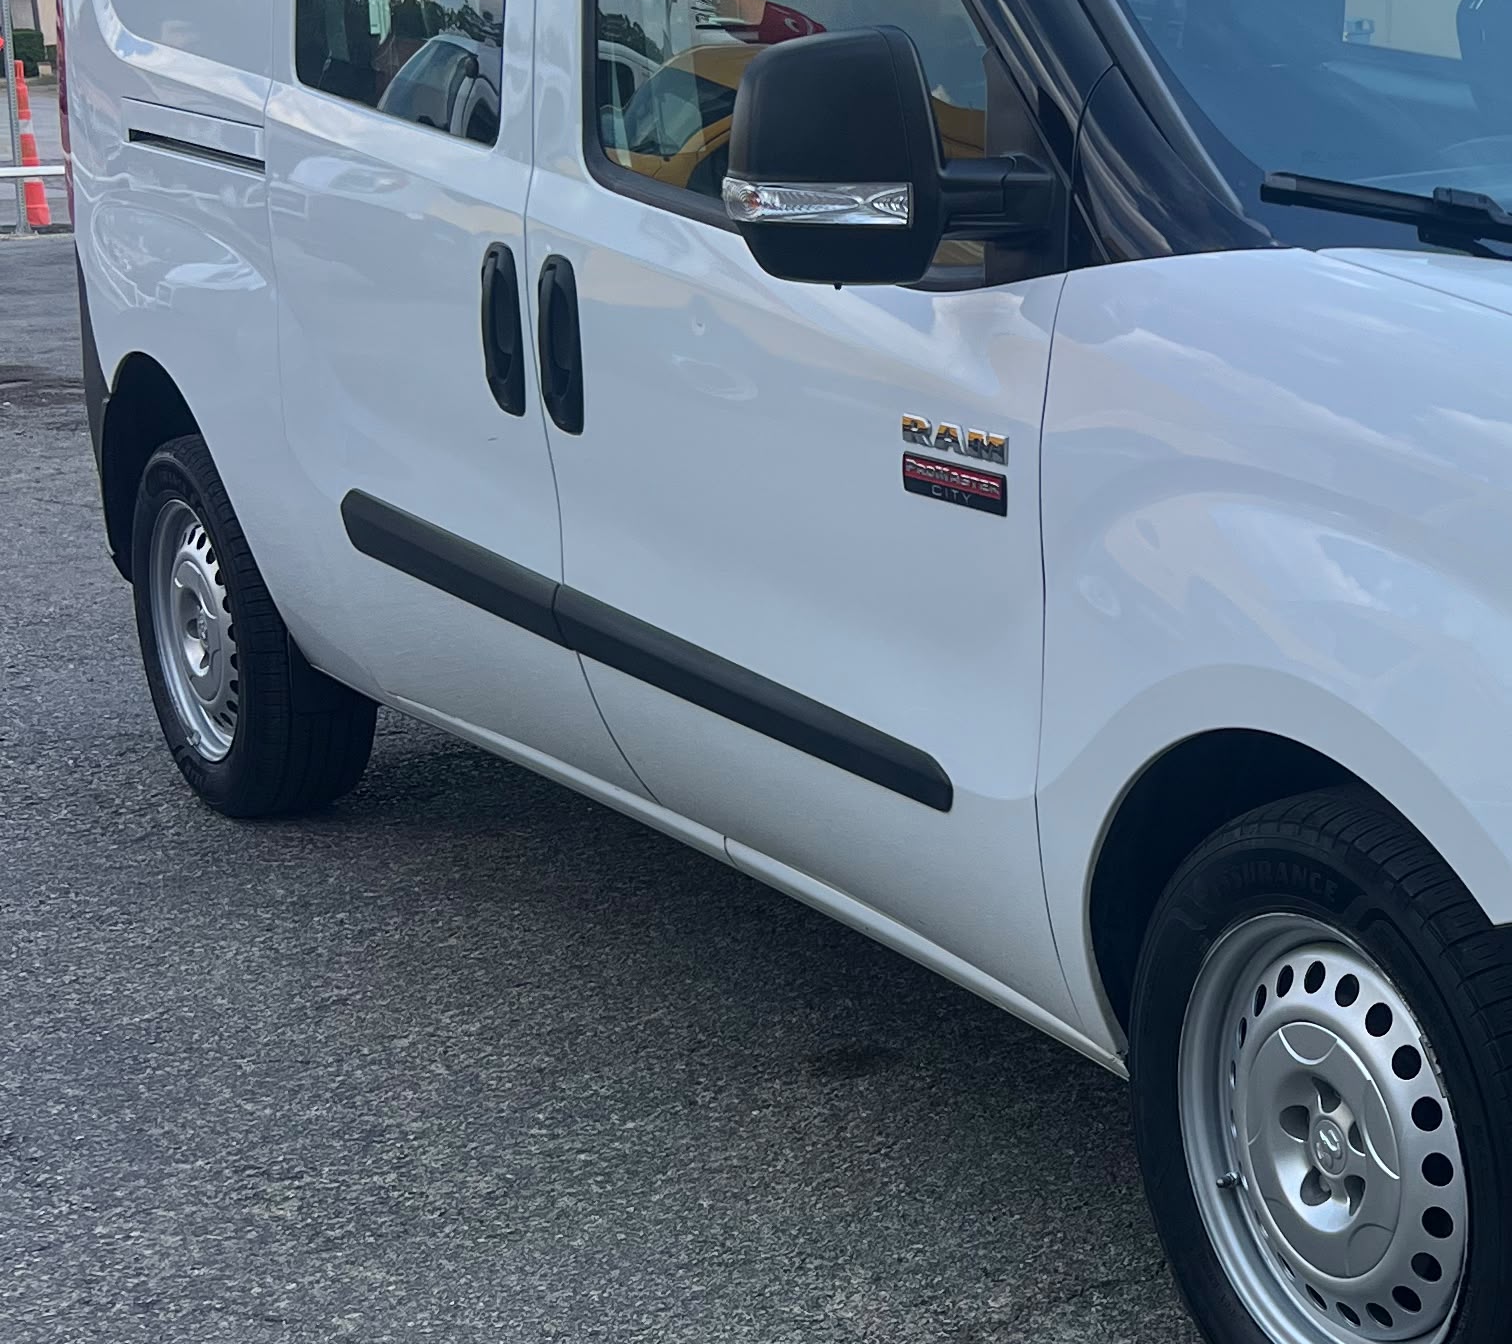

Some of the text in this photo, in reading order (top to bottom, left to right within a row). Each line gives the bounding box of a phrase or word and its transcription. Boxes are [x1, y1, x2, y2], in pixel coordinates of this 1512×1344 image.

[902, 412, 1010, 467] RAM
[905, 457, 1001, 495] PROMASTER
[931, 484, 973, 506] CITY
